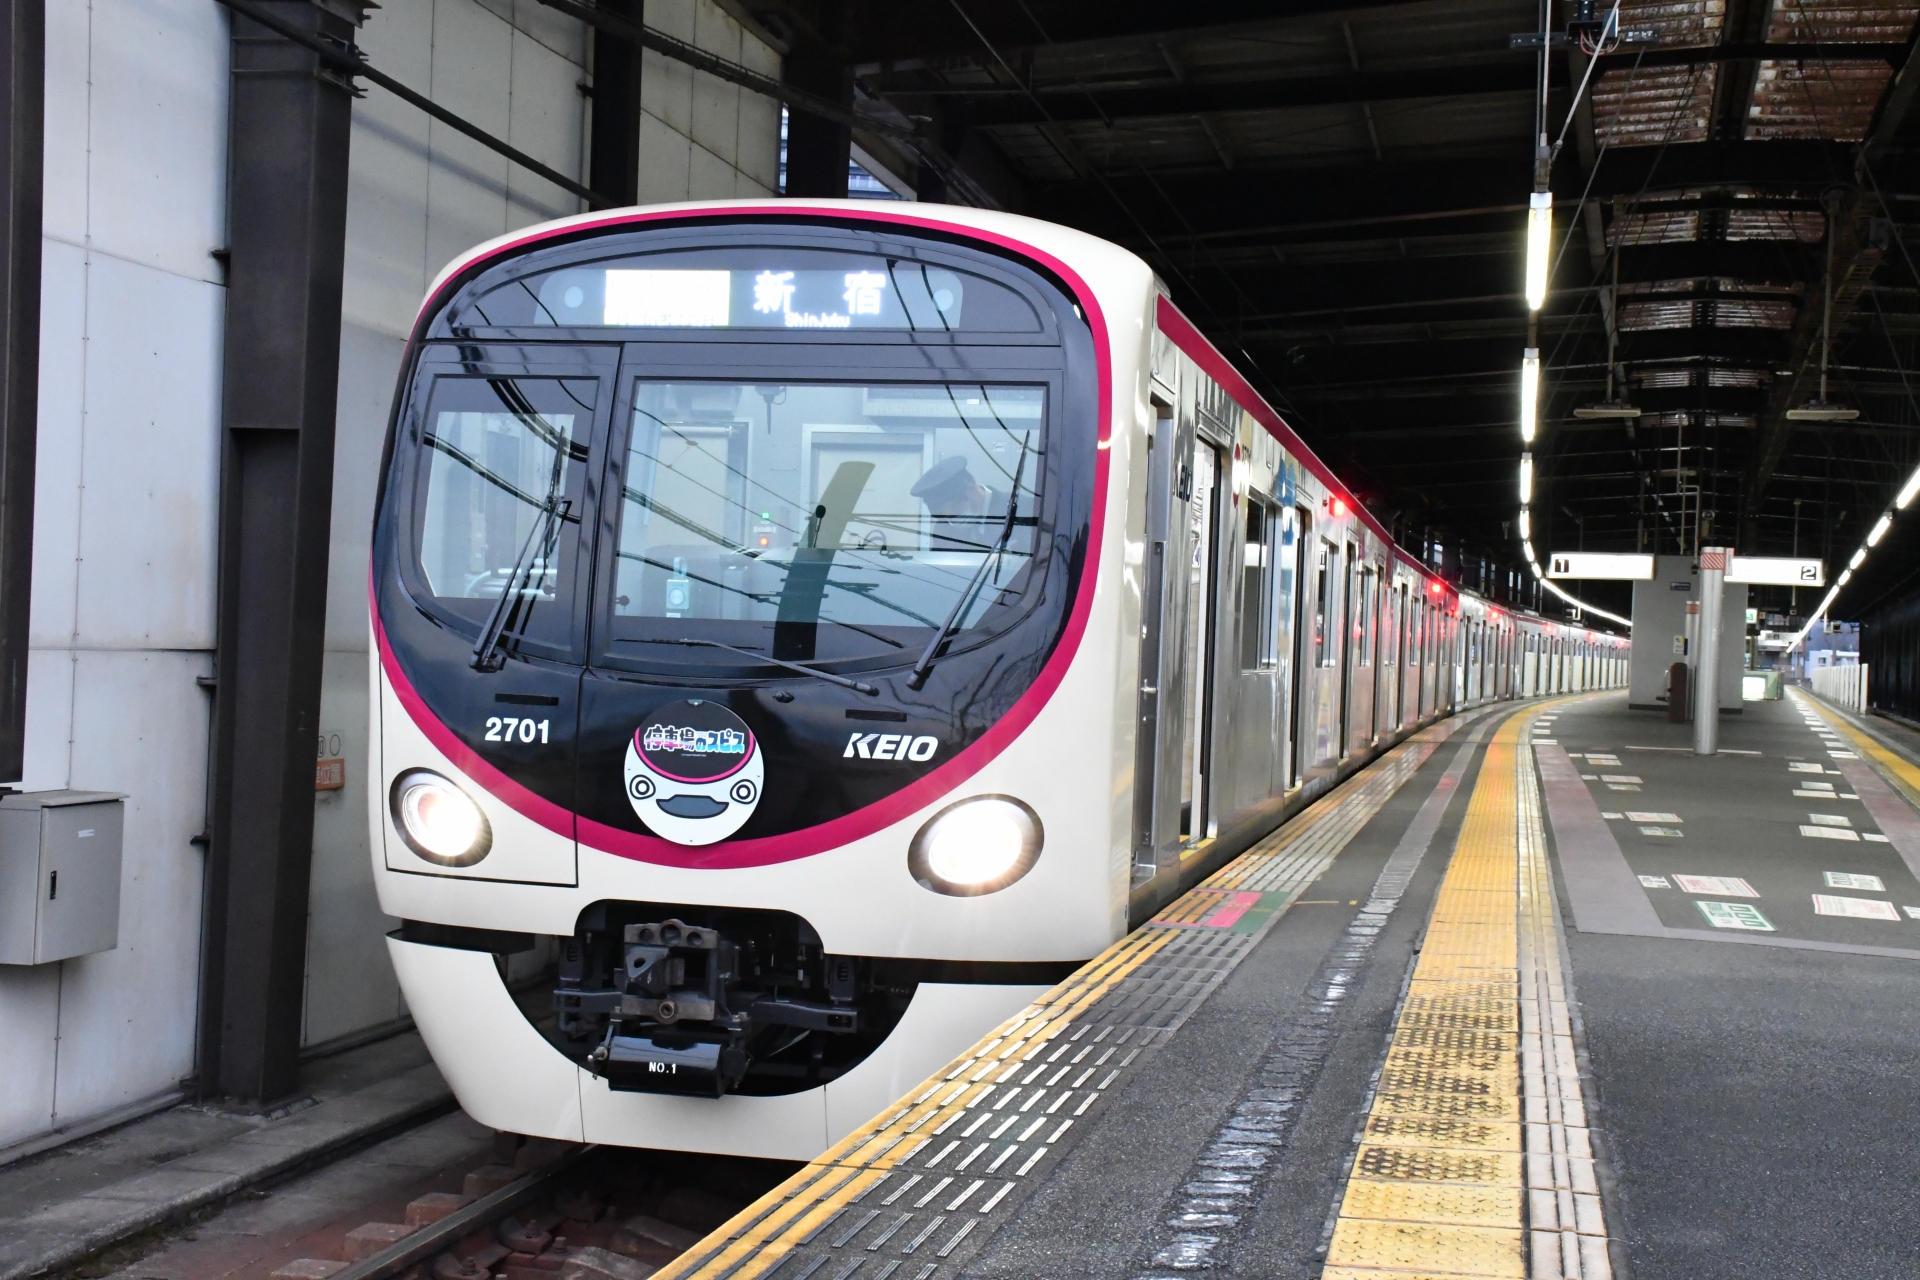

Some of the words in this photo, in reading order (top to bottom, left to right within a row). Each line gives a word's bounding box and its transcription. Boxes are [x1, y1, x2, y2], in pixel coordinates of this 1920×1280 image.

[1802, 567, 1815, 580] 2
[484, 716, 549, 744] 2701
[842, 732, 939, 762] KEIO
